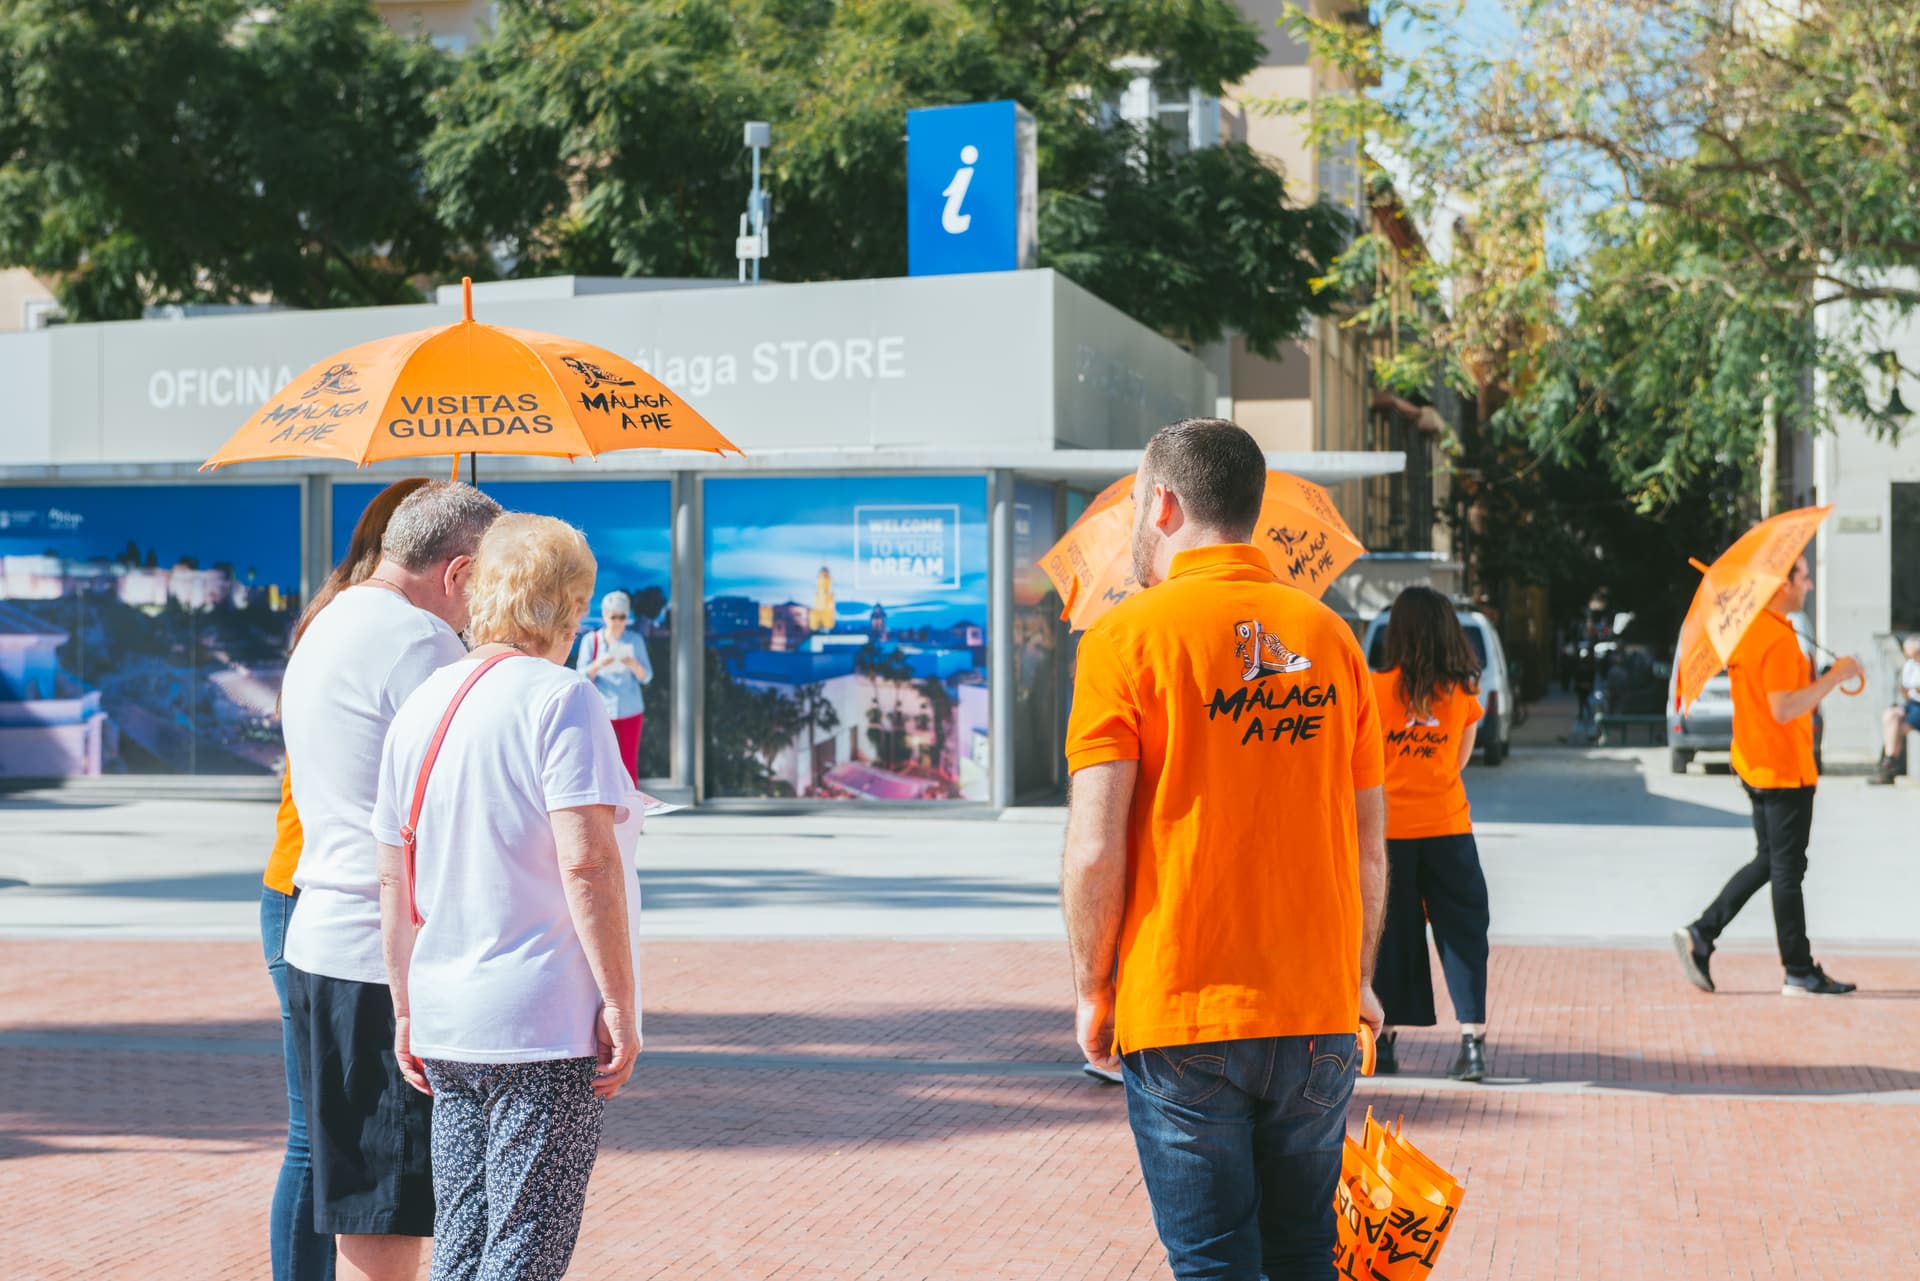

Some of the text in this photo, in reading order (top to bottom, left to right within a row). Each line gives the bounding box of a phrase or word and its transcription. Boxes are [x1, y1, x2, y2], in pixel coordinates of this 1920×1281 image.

[751, 336, 906, 384] STORE
[260, 399, 369, 427] MÁLAGA
[400, 393, 539, 415] VISITAS
[577, 389, 673, 416] MÁLAGA
[388, 414, 554, 439] GUIADAS
[621, 412, 673, 432] A PIE
[270, 423, 340, 444] A PIE
[868, 518, 944, 533] WELCOME
[871, 538, 944, 556] TO YOUR
[869, 556, 944, 577] DREAM
[1203, 680, 1337, 724] MÁLAGA
[1241, 713, 1325, 746] A PIE
[1399, 744, 1438, 759] A PIE
